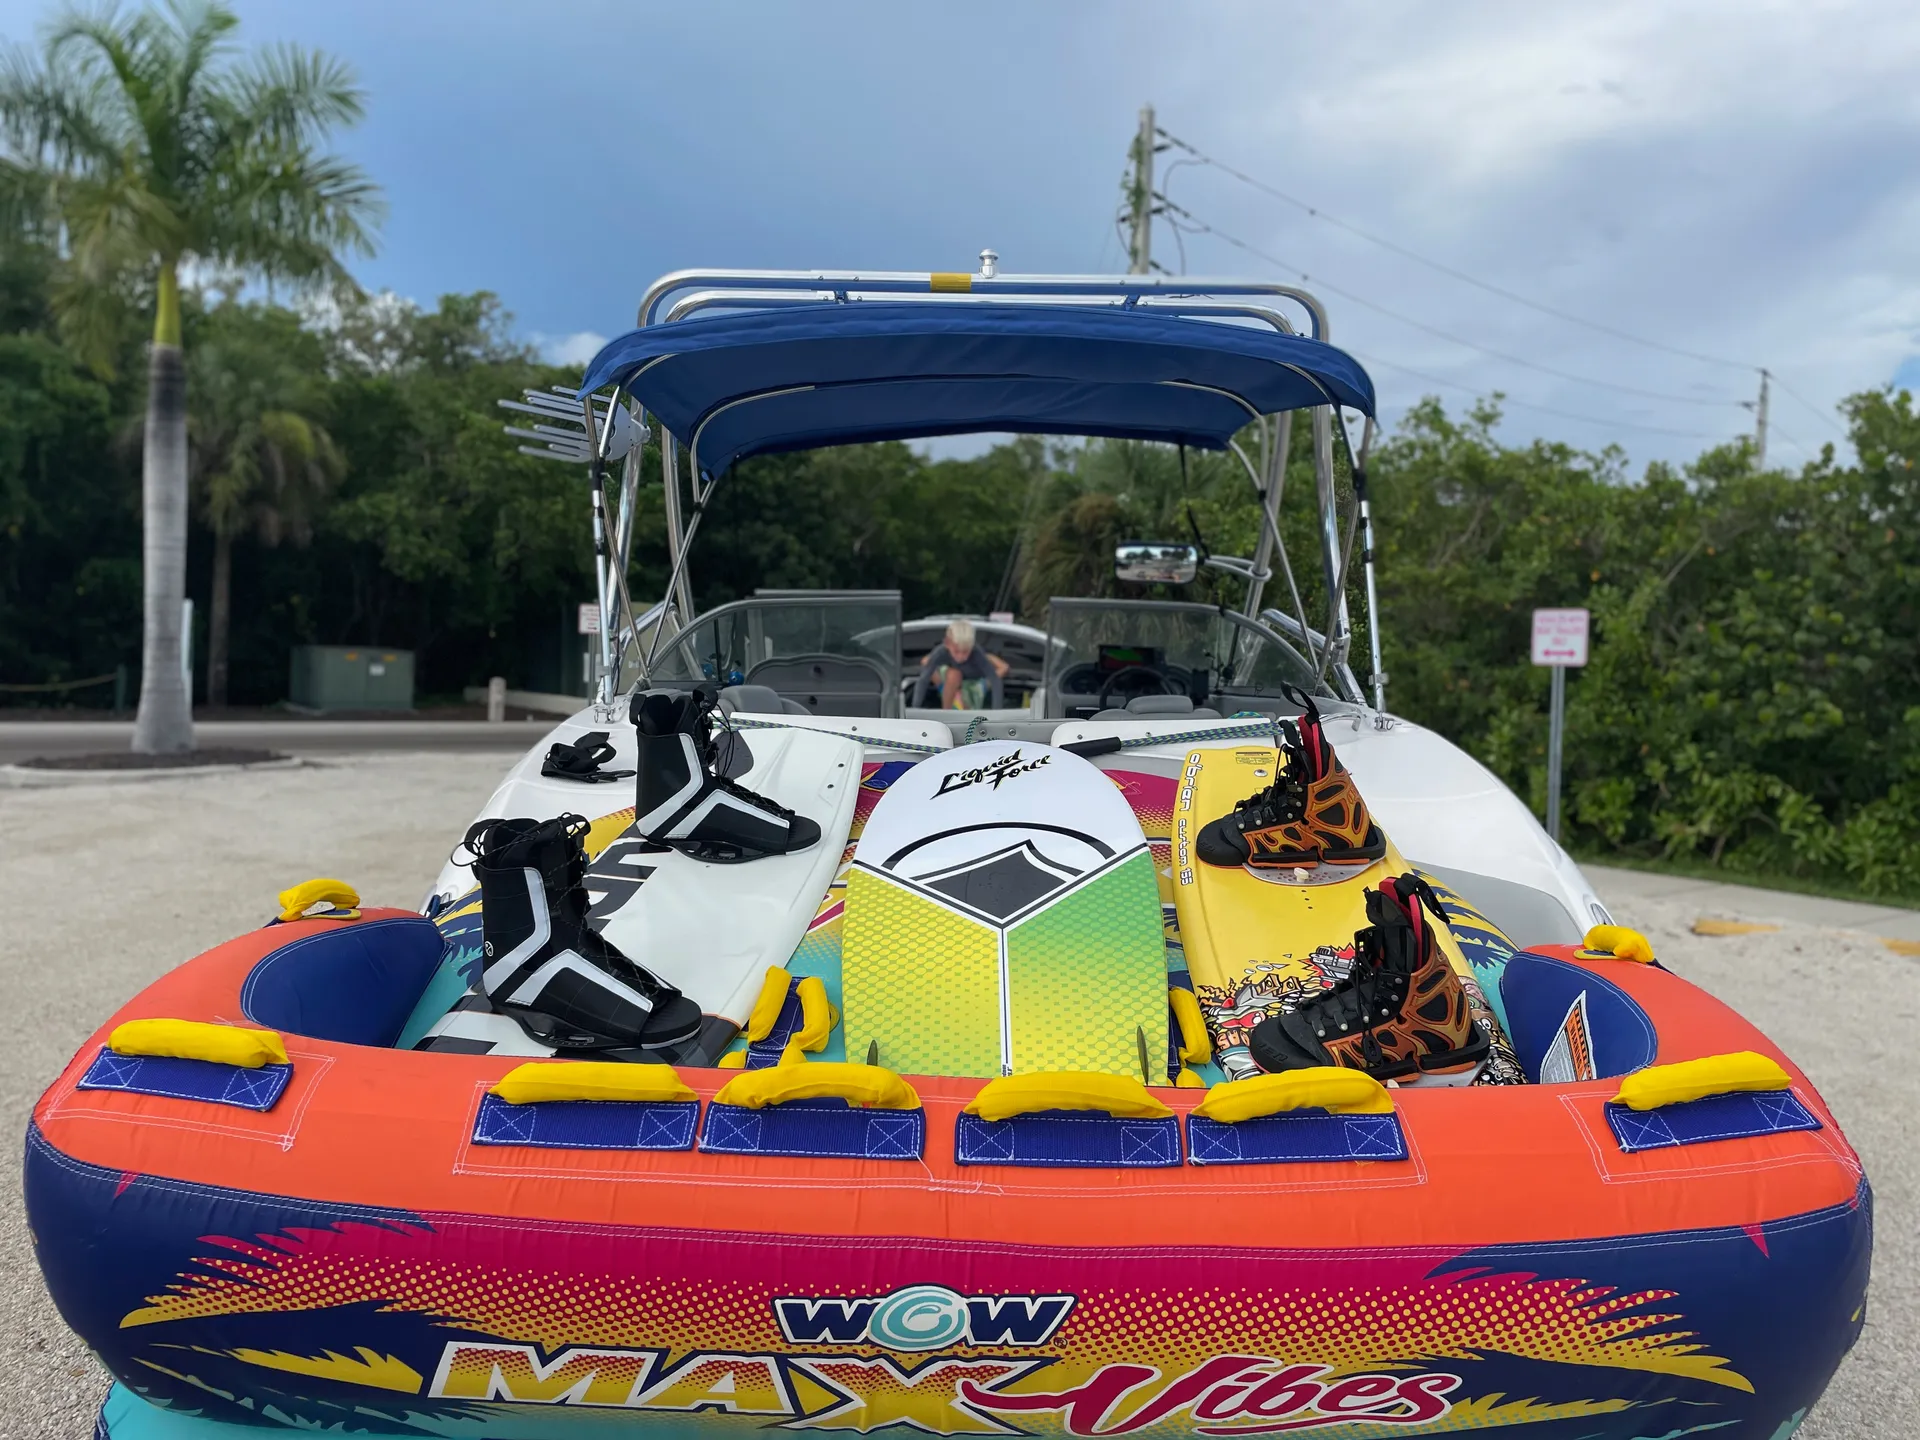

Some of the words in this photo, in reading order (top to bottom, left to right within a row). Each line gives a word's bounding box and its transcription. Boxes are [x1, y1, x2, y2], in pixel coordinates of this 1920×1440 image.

[930, 748, 1028, 800] Liquid
[985, 754, 1053, 791] Force
[773, 1284, 1078, 1352] WOW
[427, 1341, 1055, 1435] MAX
[956, 1354, 1464, 1436] Vibes
